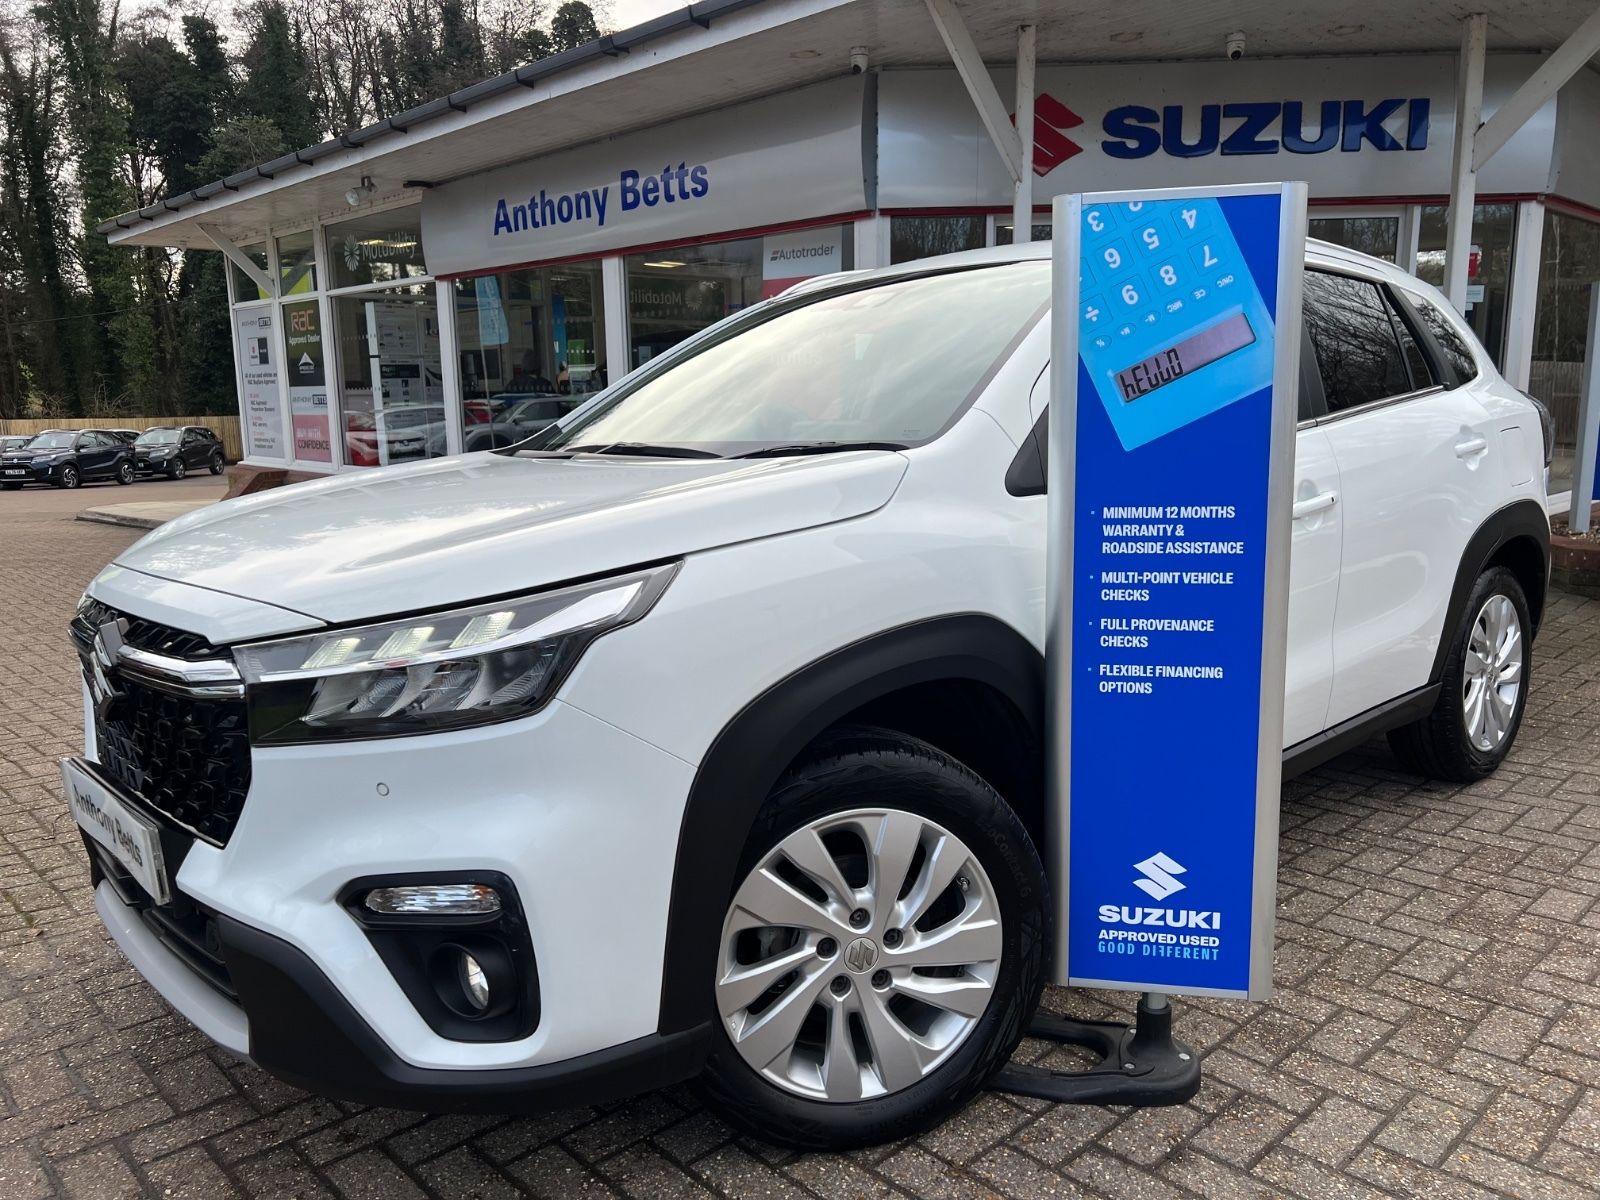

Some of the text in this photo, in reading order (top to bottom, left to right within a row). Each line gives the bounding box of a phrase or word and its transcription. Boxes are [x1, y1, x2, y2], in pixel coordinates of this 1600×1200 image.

[1101, 98, 1430, 159] SUZUKI
[494, 161, 708, 236] Anthony Betts
[1087, 211, 1104, 232] 3
[1181, 208, 1197, 229] 4
[1142, 228, 1159, 250] 5
[779, 244, 835, 260] Autotrader
[1203, 244, 1218, 267] 7
[1160, 265, 1177, 285] 8
[1194, 289, 1206, 300] CE
[288, 334, 320, 346] Approved Dealer
[297, 439, 330, 450] CONFIDENCE
[1102, 506, 1235, 519] MINIMUM 12 MONTHS
[1102, 524, 1185, 537] WARRANTY &
[1102, 541, 1244, 554] ROADSIDE ASSISTANCE
[1101, 571, 1234, 584] MULTI-POINT VEHICLE
[1101, 589, 1150, 601] CHECKS
[1100, 618, 1215, 632] FULL PROVENANCE
[1100, 635, 1149, 648] CHECKS
[1099, 664, 1223, 679] FLEXIBLE FINANCING
[1099, 681, 1153, 694] OPTIONS
[73, 784, 143, 867] Anthony Betts
[1098, 904, 1221, 930] SUZUKI
[1098, 929, 1220, 947] APPROVED USED
[1098, 941, 1219, 960] GOOD DIFFERENT
